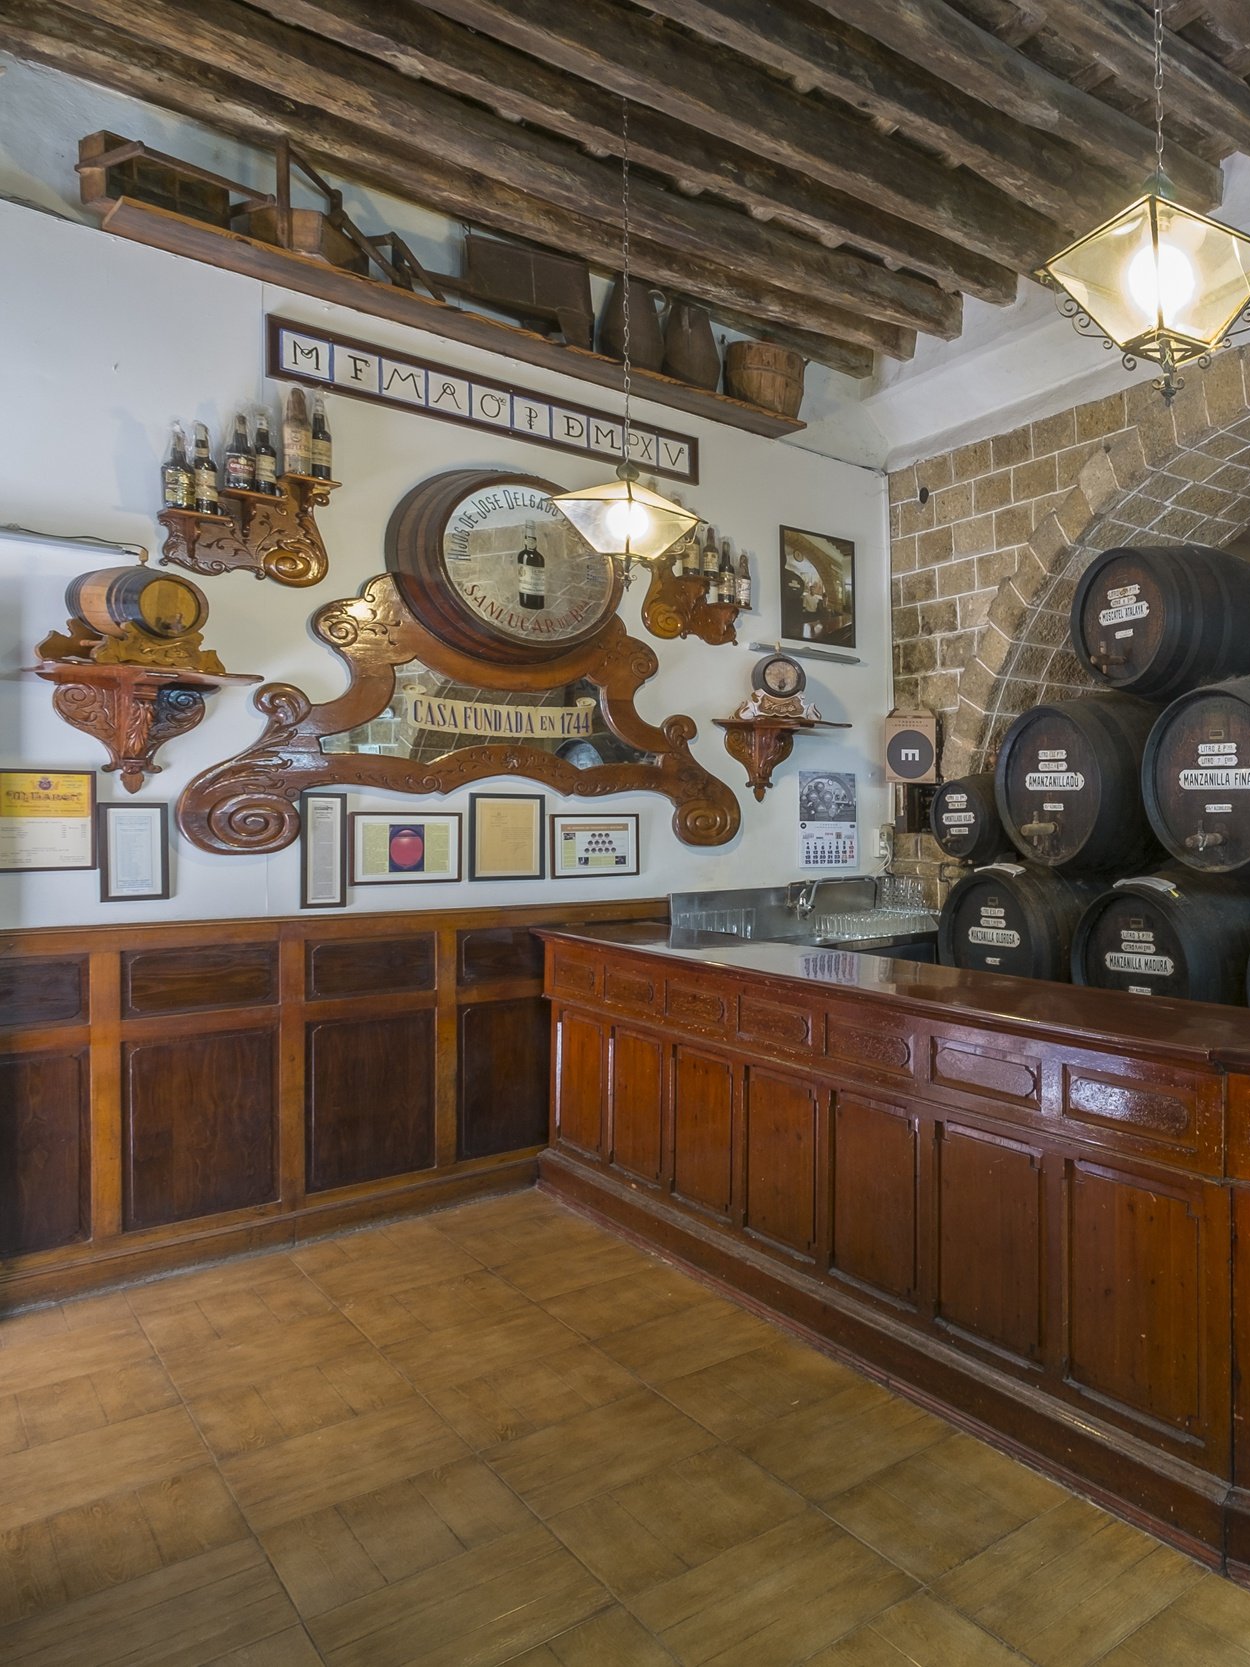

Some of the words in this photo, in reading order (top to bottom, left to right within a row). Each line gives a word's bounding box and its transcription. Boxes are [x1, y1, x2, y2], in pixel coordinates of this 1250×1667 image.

[413, 700, 458, 728] CASA
[463, 707, 535, 733] FUNDADA
[540, 716, 555, 731] EN
[560, 713, 590, 734] 1744
[1029, 776, 1079, 787] AMANZANILLADO
[1184, 774, 1231, 785] MANZANILLA
[1110, 955, 1143, 970] MANZANILLA
[1145, 958, 1168, 972] MADURA
